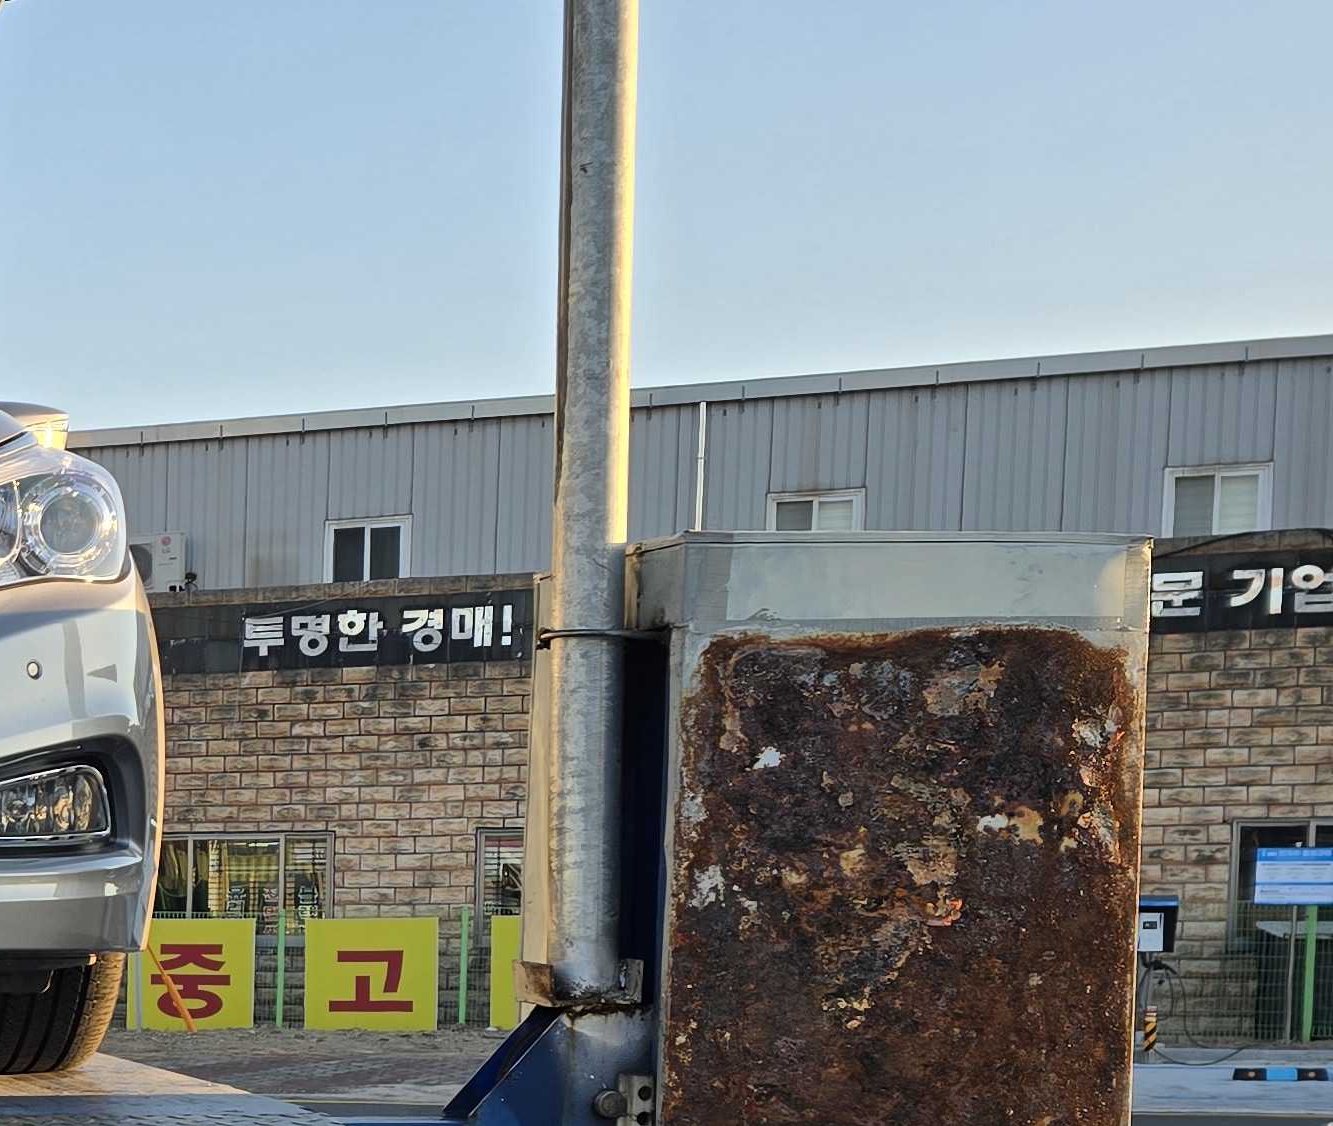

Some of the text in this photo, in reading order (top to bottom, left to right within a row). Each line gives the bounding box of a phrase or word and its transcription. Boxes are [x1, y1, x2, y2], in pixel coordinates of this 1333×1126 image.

[1230, 564, 1333, 614] 기업
[244, 605, 512, 656] 투명한 경매!
[151, 944, 414, 1018] 중 고
